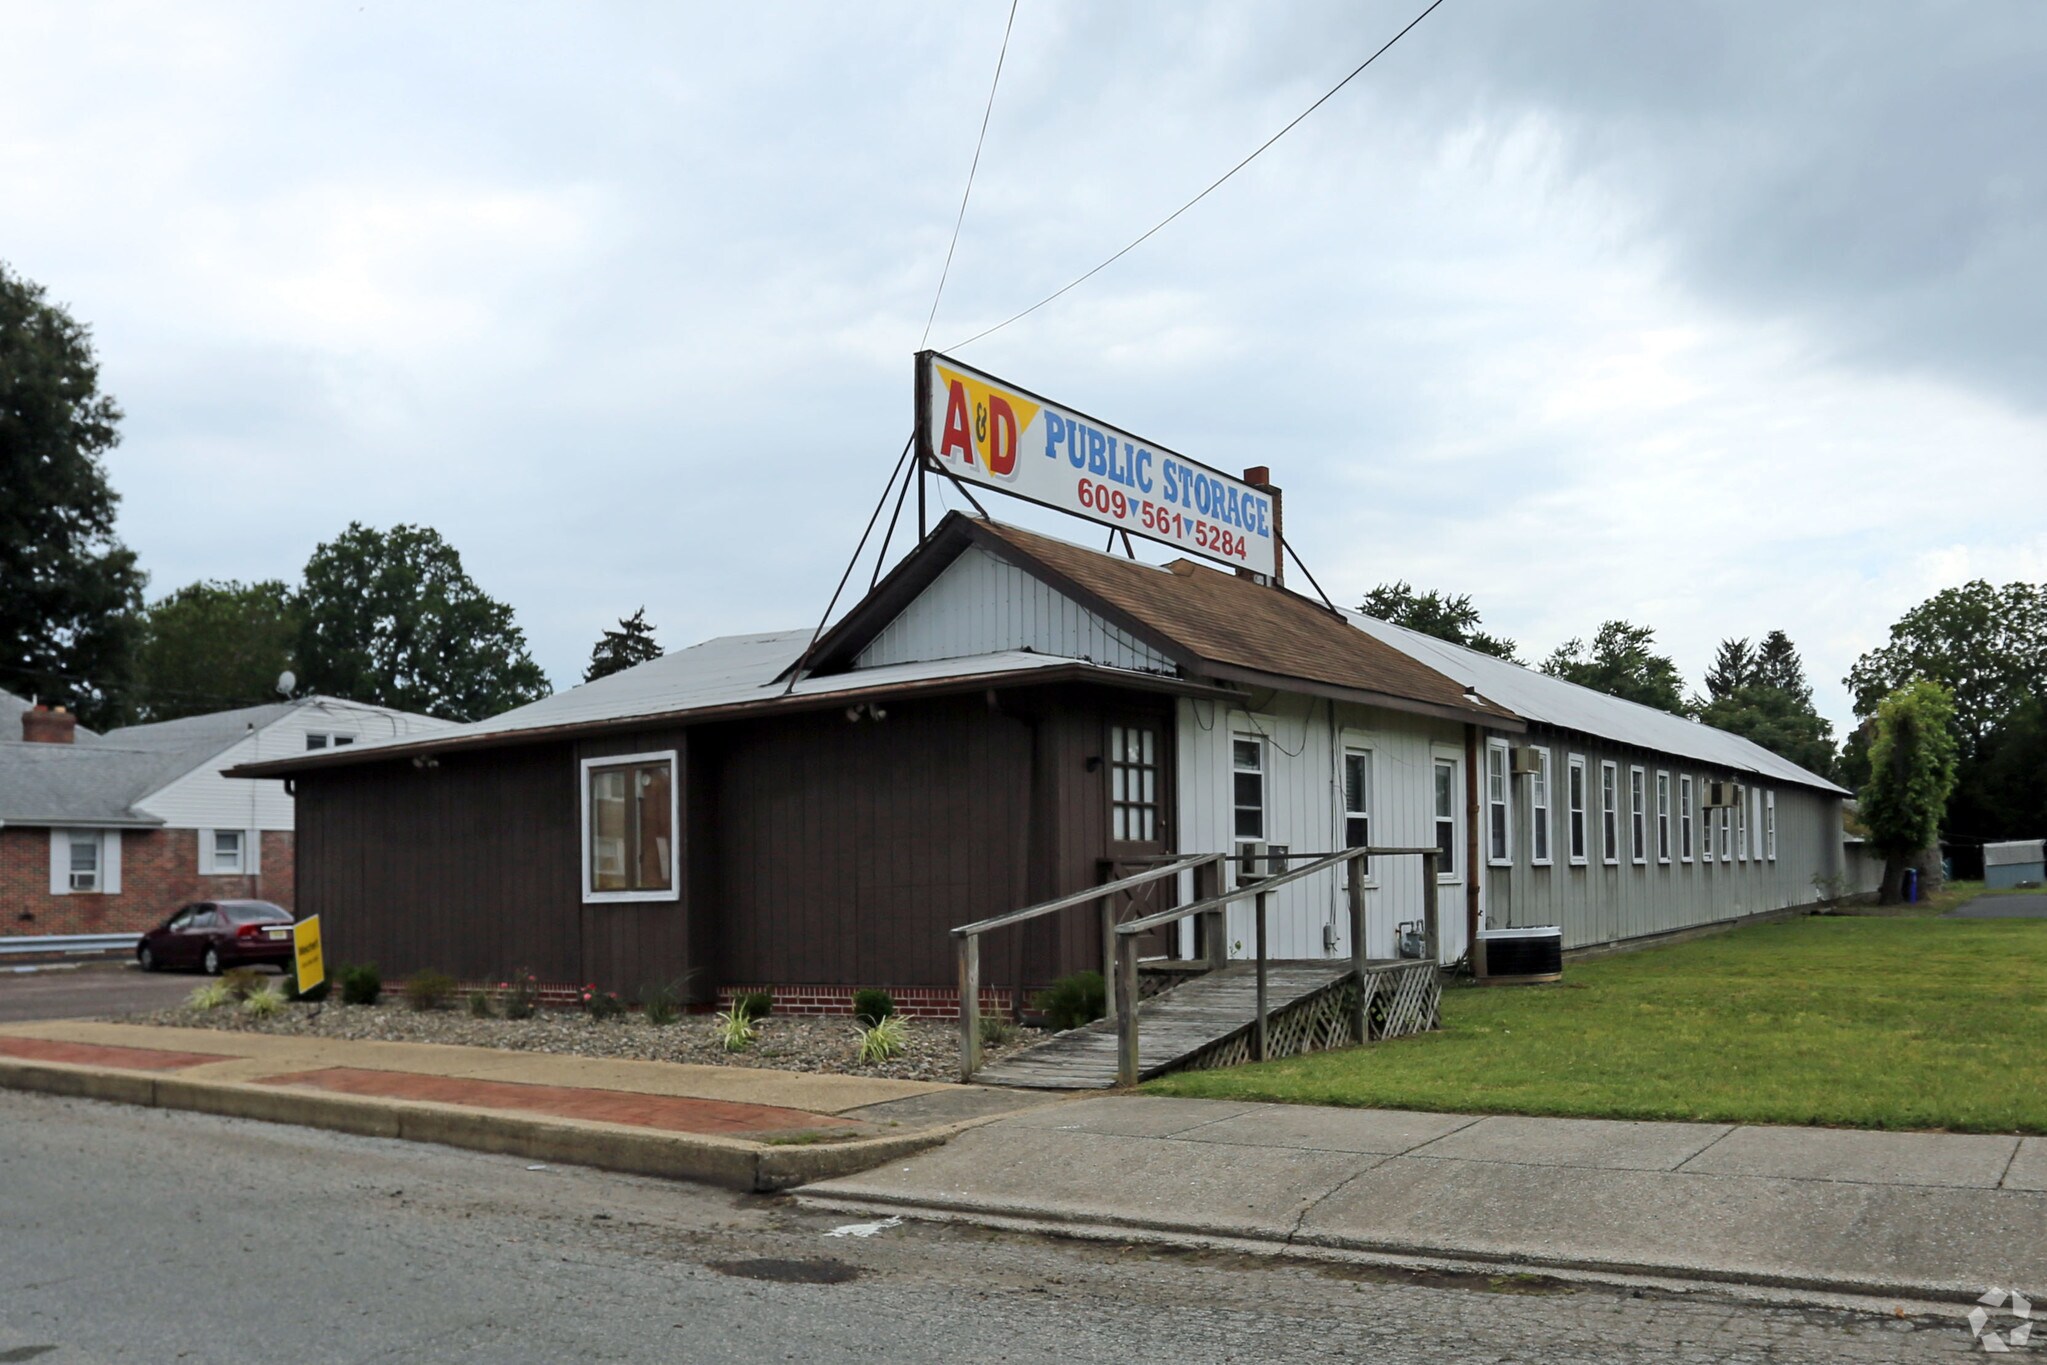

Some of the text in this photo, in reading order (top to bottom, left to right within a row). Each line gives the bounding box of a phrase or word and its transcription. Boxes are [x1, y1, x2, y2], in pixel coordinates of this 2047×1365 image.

[1043, 409, 1153, 494] PUBLIC
[1162, 458, 1269, 538] STORAGE
[1195, 519, 1247, 560] 5284
